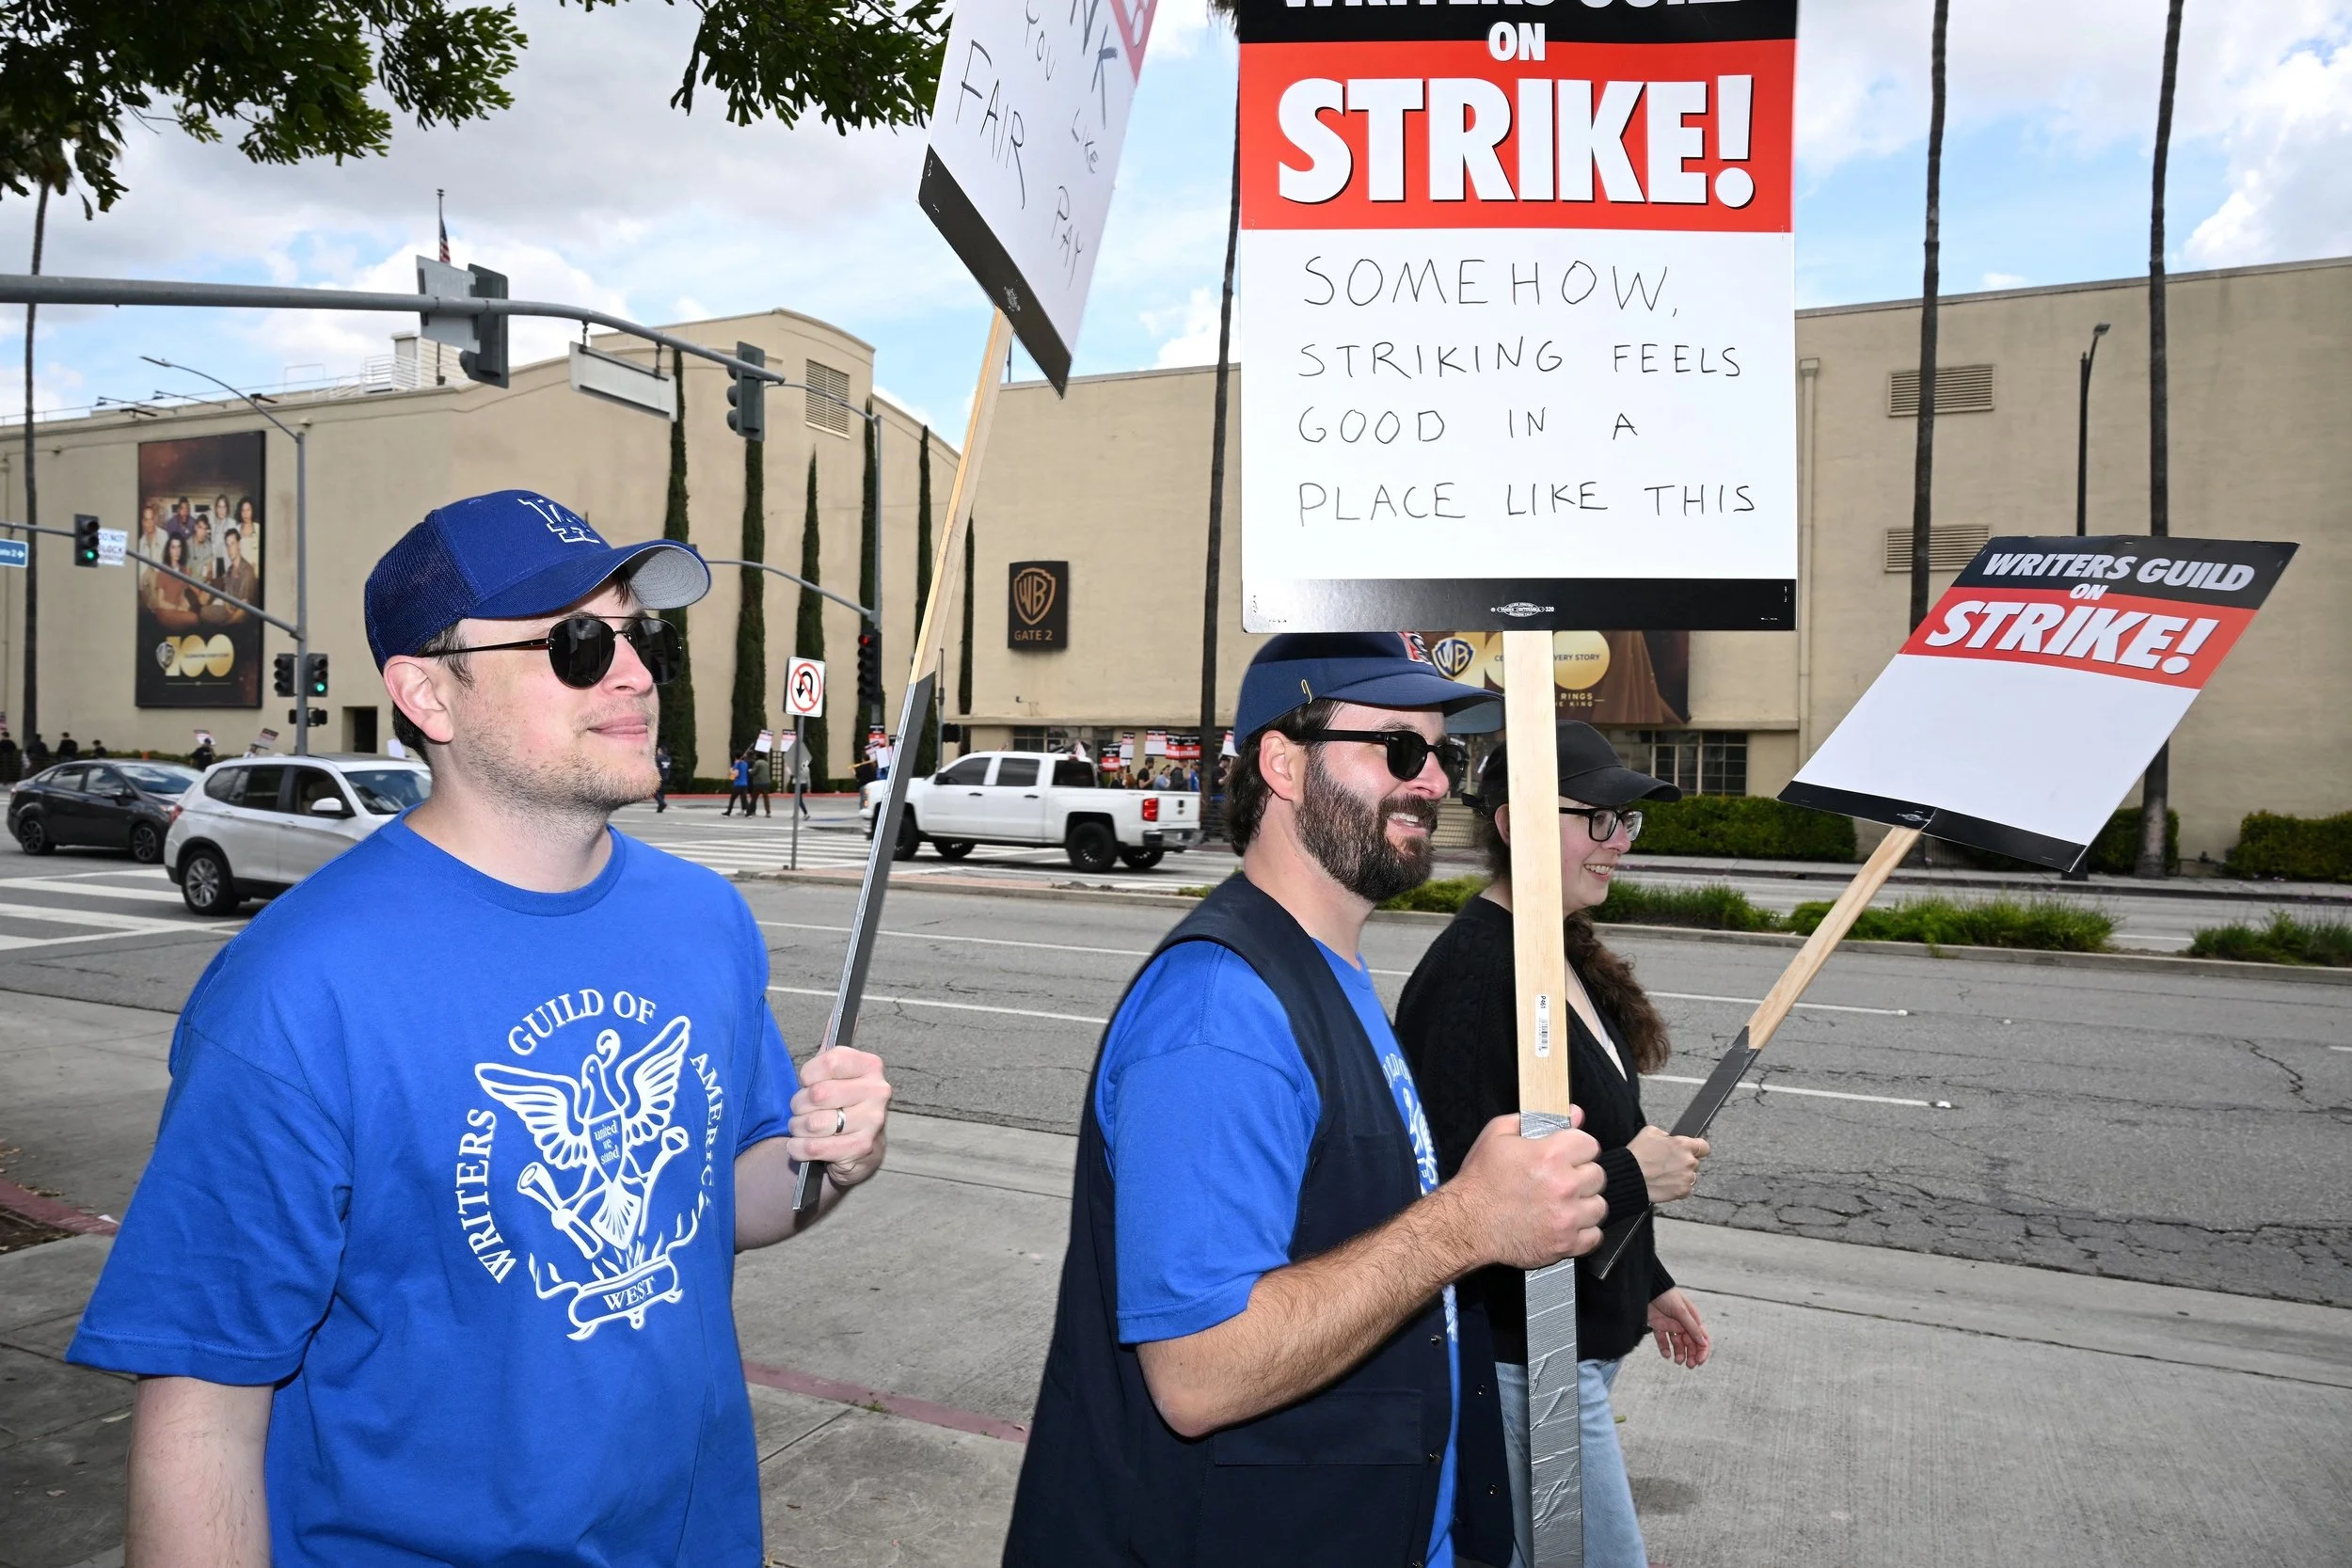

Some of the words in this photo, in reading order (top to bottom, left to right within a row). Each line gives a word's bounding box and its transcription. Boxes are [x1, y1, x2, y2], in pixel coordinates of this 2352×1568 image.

[1488, 21, 1546, 61] ON
[1278, 74, 1756, 209] STRIKE!
[956, 39, 1025, 210] FAIR
[1051, 185, 1083, 291] PAY
[1303, 255, 1678, 317] SOMEHOW,
[1298, 335, 1563, 379] STRIKING
[1613, 342, 1740, 376] FEELS
[1298, 405, 1445, 444] GOOD
[1508, 406, 1546, 438] IN
[1613, 412, 1638, 440] A
[517, 496, 601, 544] LA
[1298, 482, 1466, 527] PLACE
[1506, 481, 1609, 515] LIKE
[1644, 483, 1756, 516] THIS
[1982, 553, 2135, 580] WRITERS
[2137, 559, 2255, 591] GUILD
[2070, 582, 2108, 600] ON
[1015, 630, 1042, 641] GATE
[1045, 630, 1054, 641] 2
[1925, 600, 2220, 674] STRIKE!
[1560, 692, 1593, 701] RINGS
[507, 989, 605, 1055] GUILD
[612, 990, 657, 1025] OF
[456, 1108, 517, 1284] WRITERS
[602, 1275, 657, 1313] WEST
